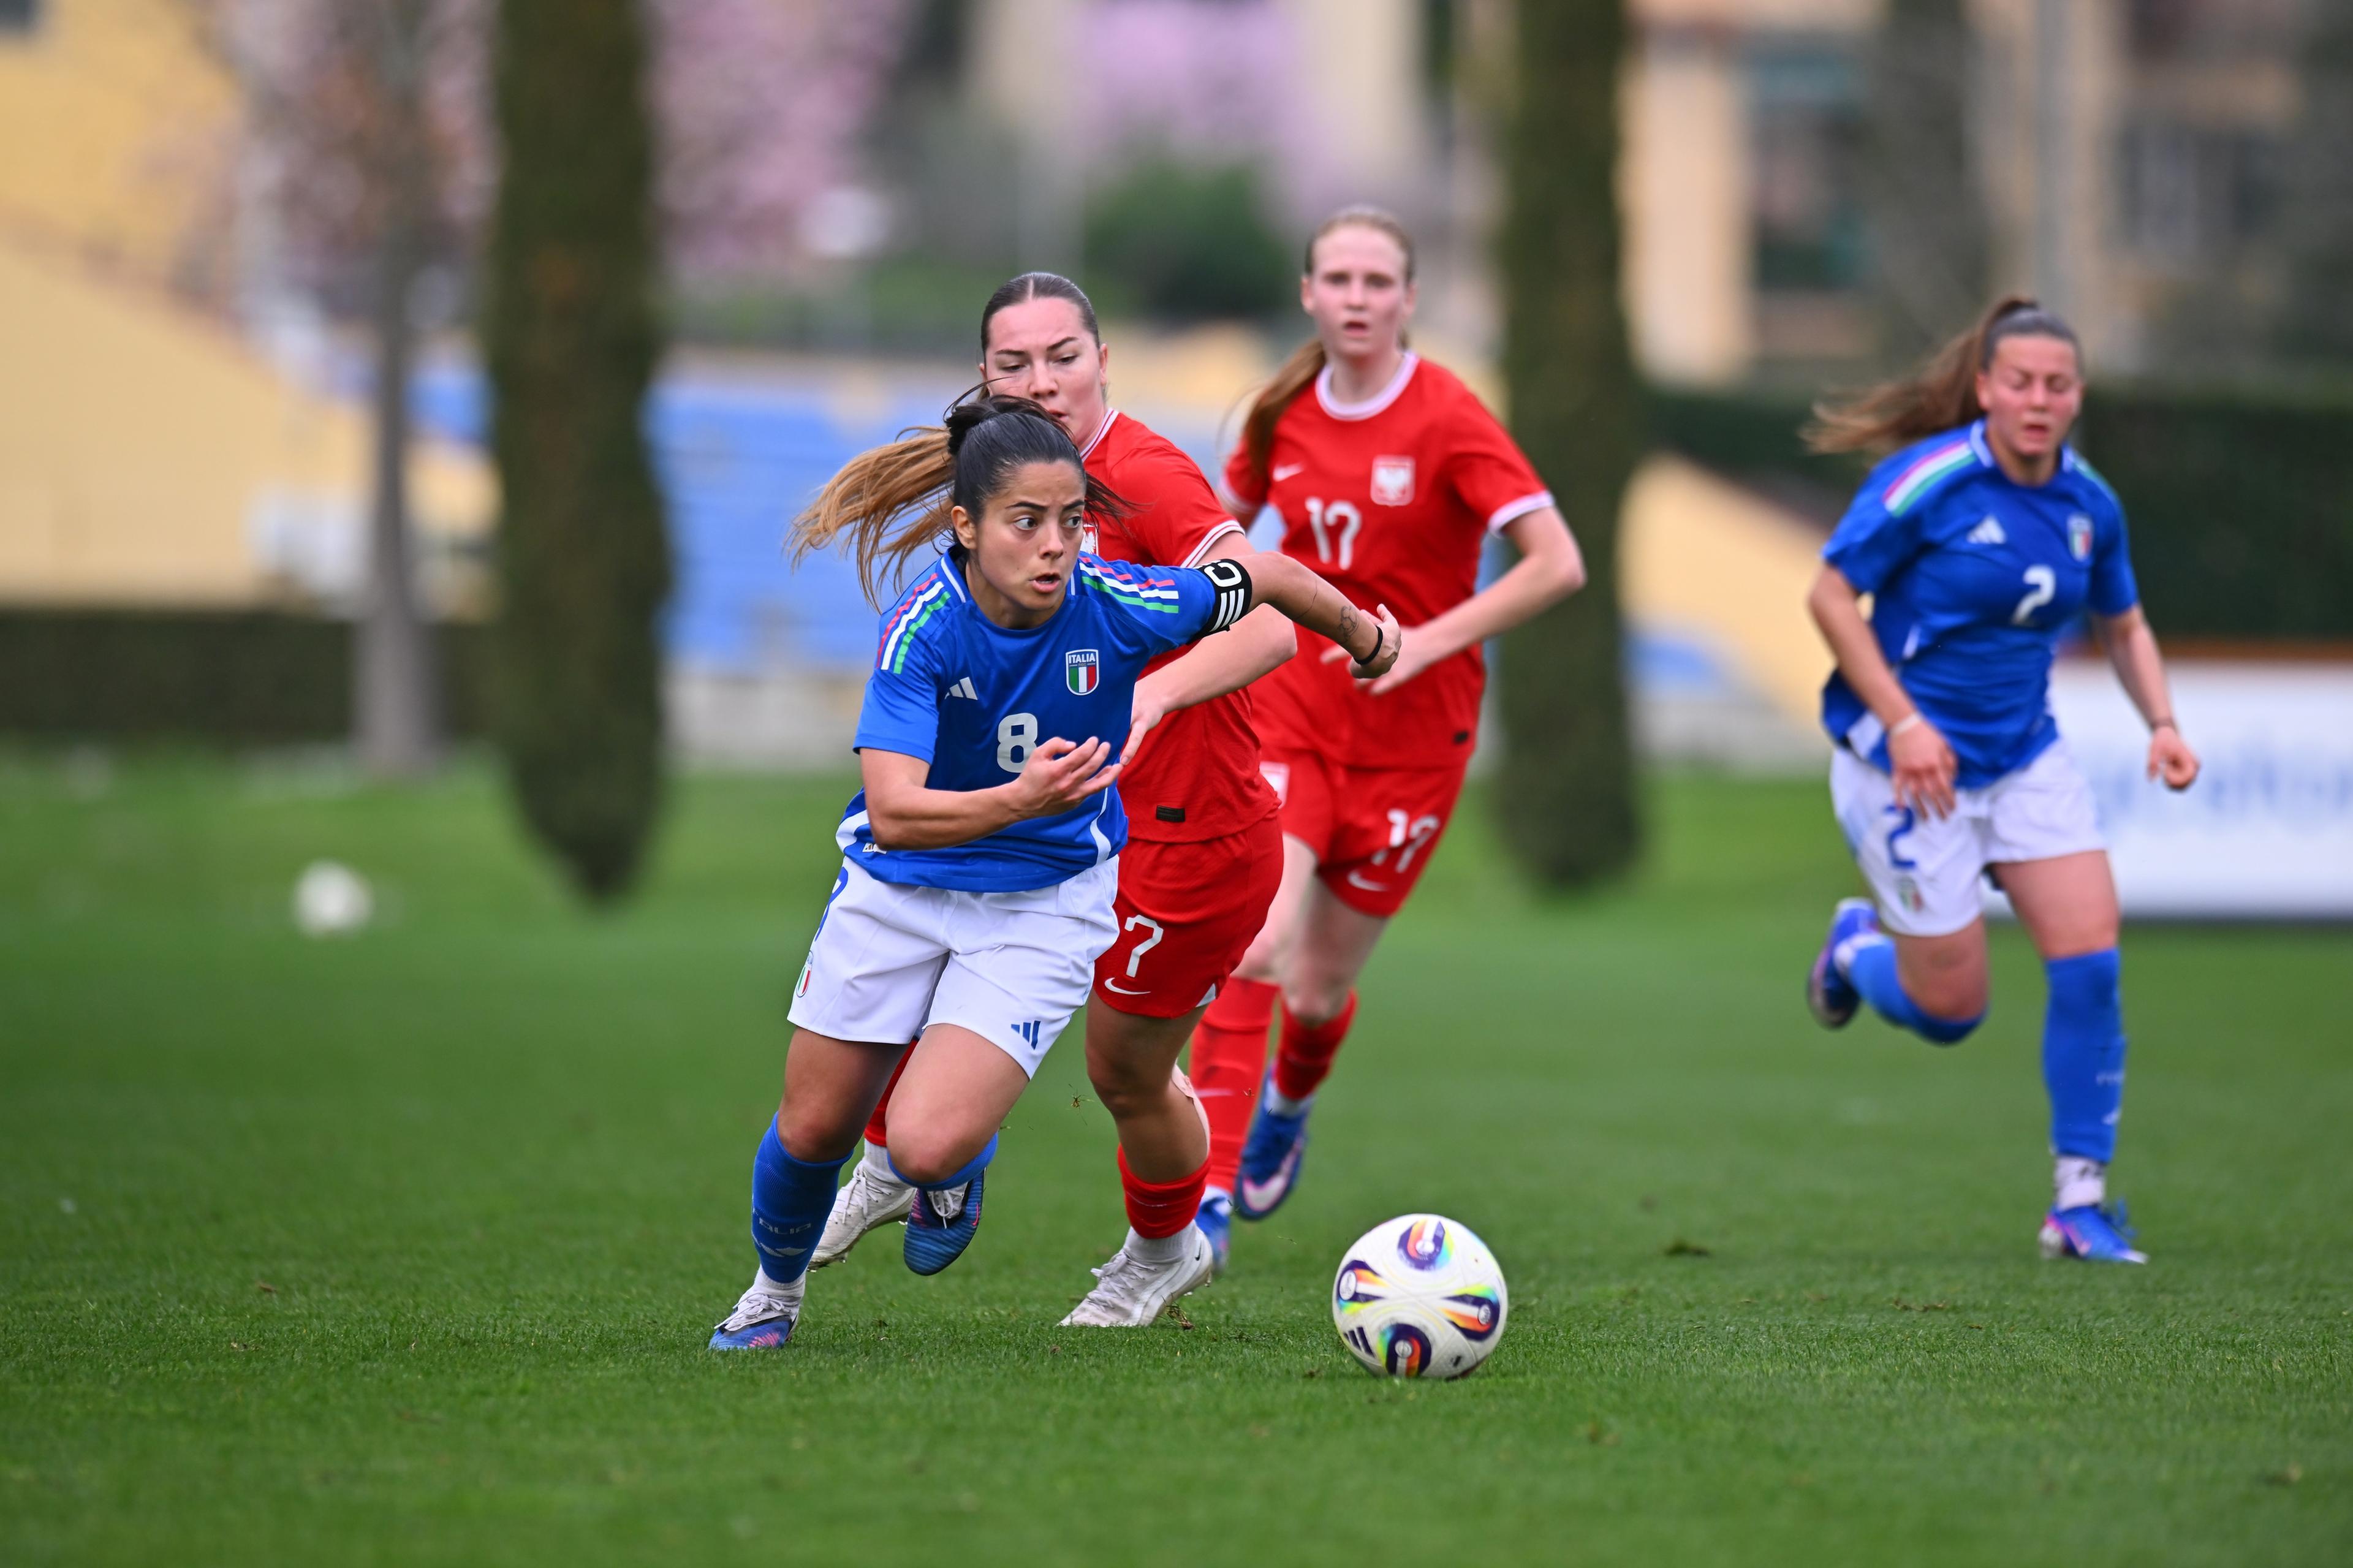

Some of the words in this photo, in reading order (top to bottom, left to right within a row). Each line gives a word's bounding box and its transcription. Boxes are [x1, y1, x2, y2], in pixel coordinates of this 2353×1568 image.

[1305, 497, 1362, 570] 17
[1204, 562, 1242, 588] C
[2012, 565, 2057, 627] 2
[1069, 653, 1096, 664] ITALIA
[998, 713, 1038, 773] 8
[1885, 805, 1917, 870] 2
[1124, 915, 1163, 977] 7
